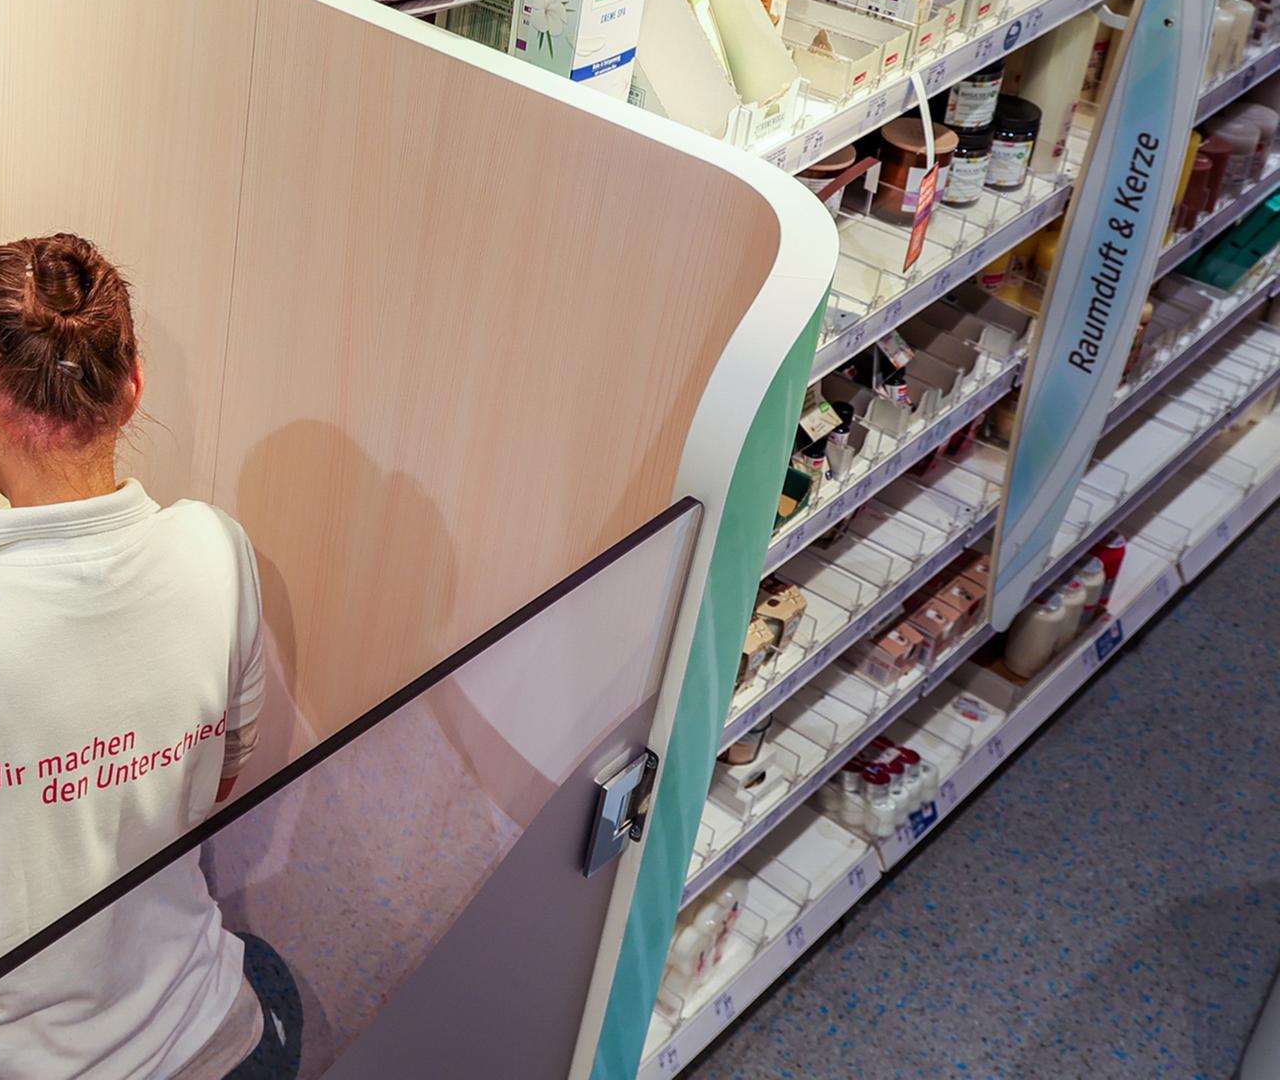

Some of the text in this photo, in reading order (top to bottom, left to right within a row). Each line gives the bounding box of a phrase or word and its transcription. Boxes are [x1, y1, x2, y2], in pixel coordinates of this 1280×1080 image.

[1069, 132, 1160, 374] Raumduft & Kerze
[38, 730, 136, 780] machen
[42, 711, 227, 805] den Unterschied
